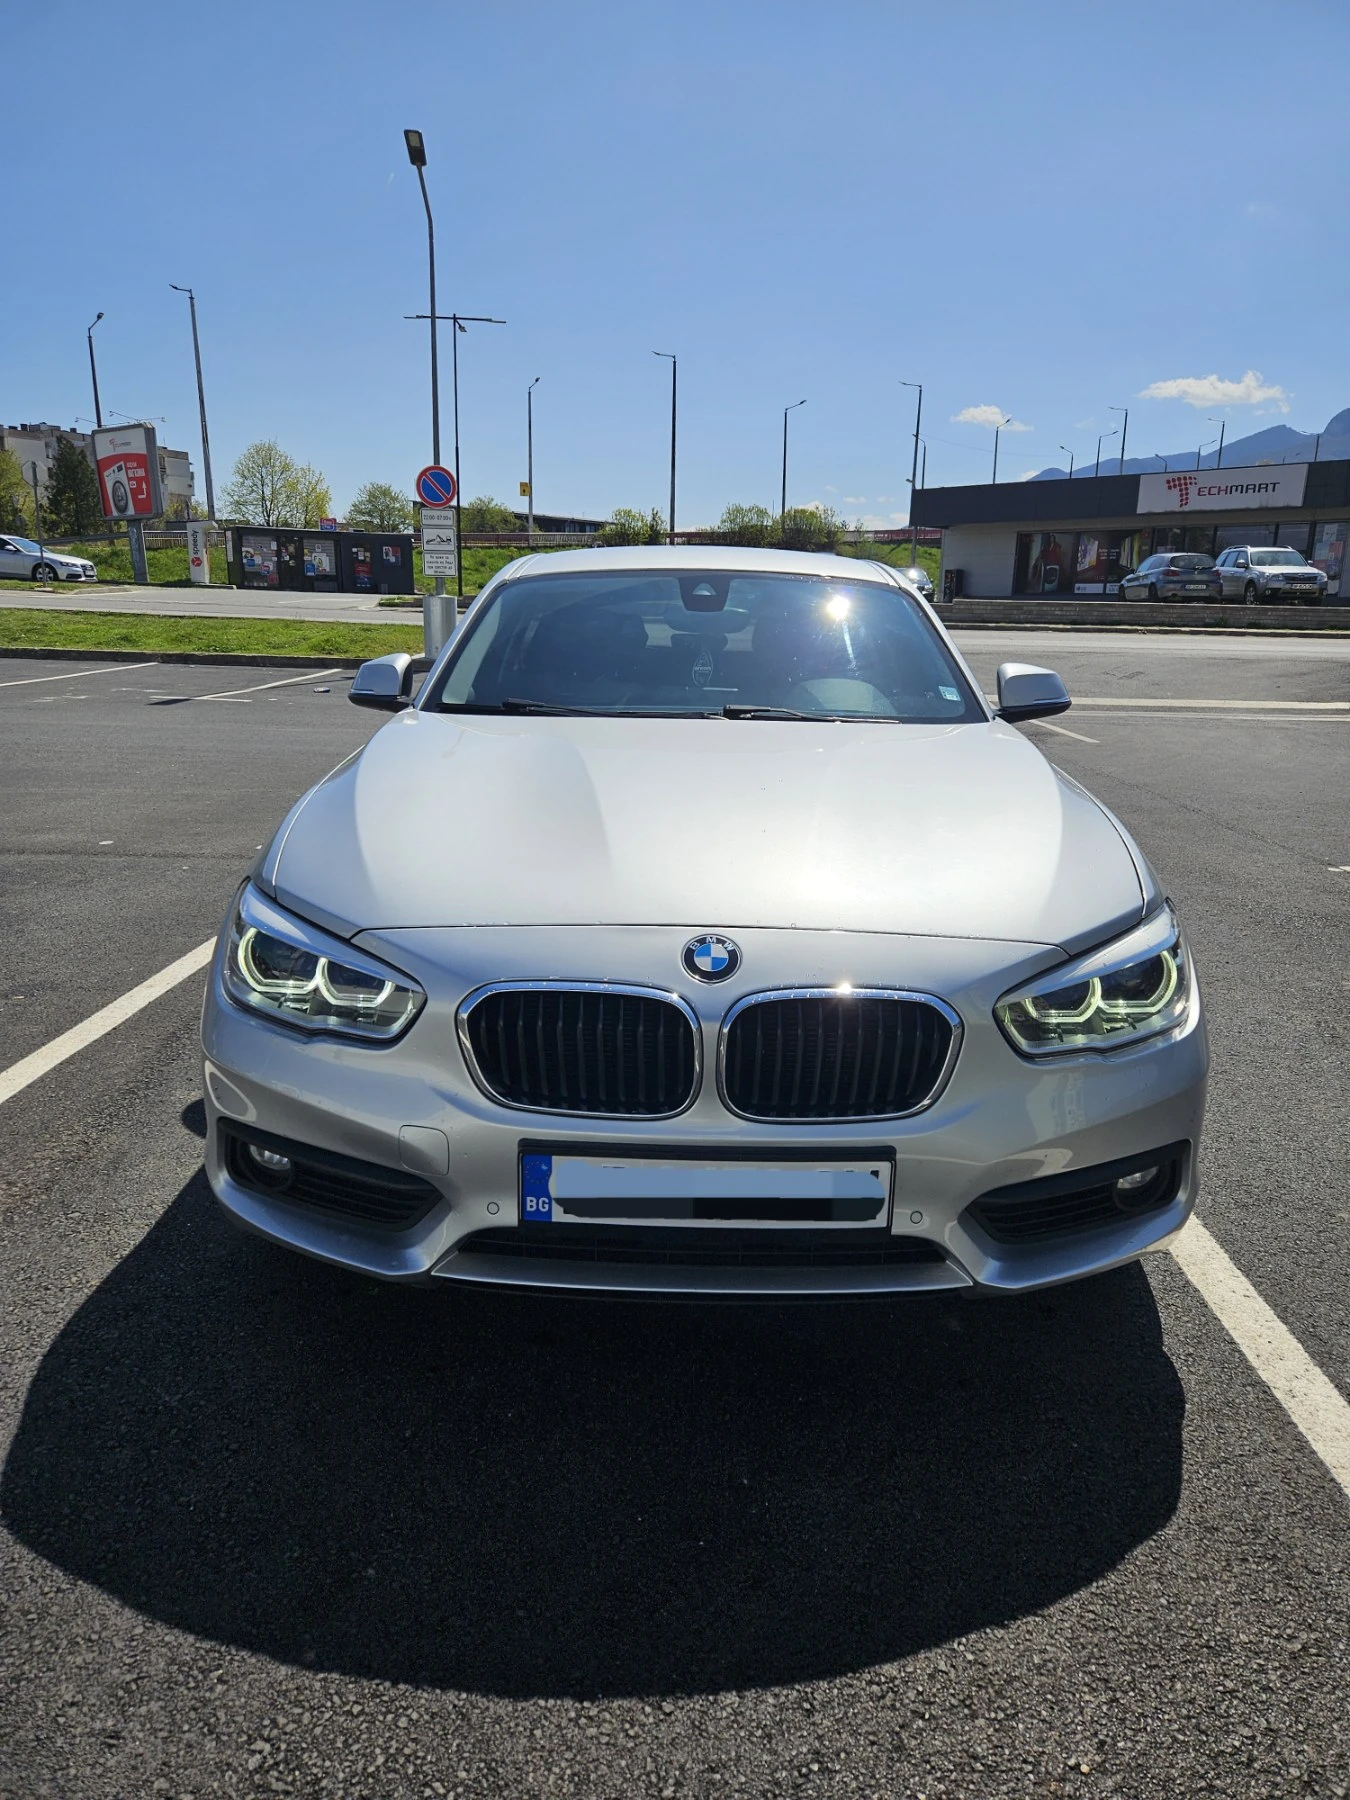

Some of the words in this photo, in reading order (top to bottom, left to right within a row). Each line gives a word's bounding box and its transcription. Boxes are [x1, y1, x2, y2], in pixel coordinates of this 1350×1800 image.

[1165, 475, 1280, 508] TECHMART
[191, 529, 199, 556] speedy
[689, 936, 736, 951] BMW
[526, 1196, 549, 1213] BG
